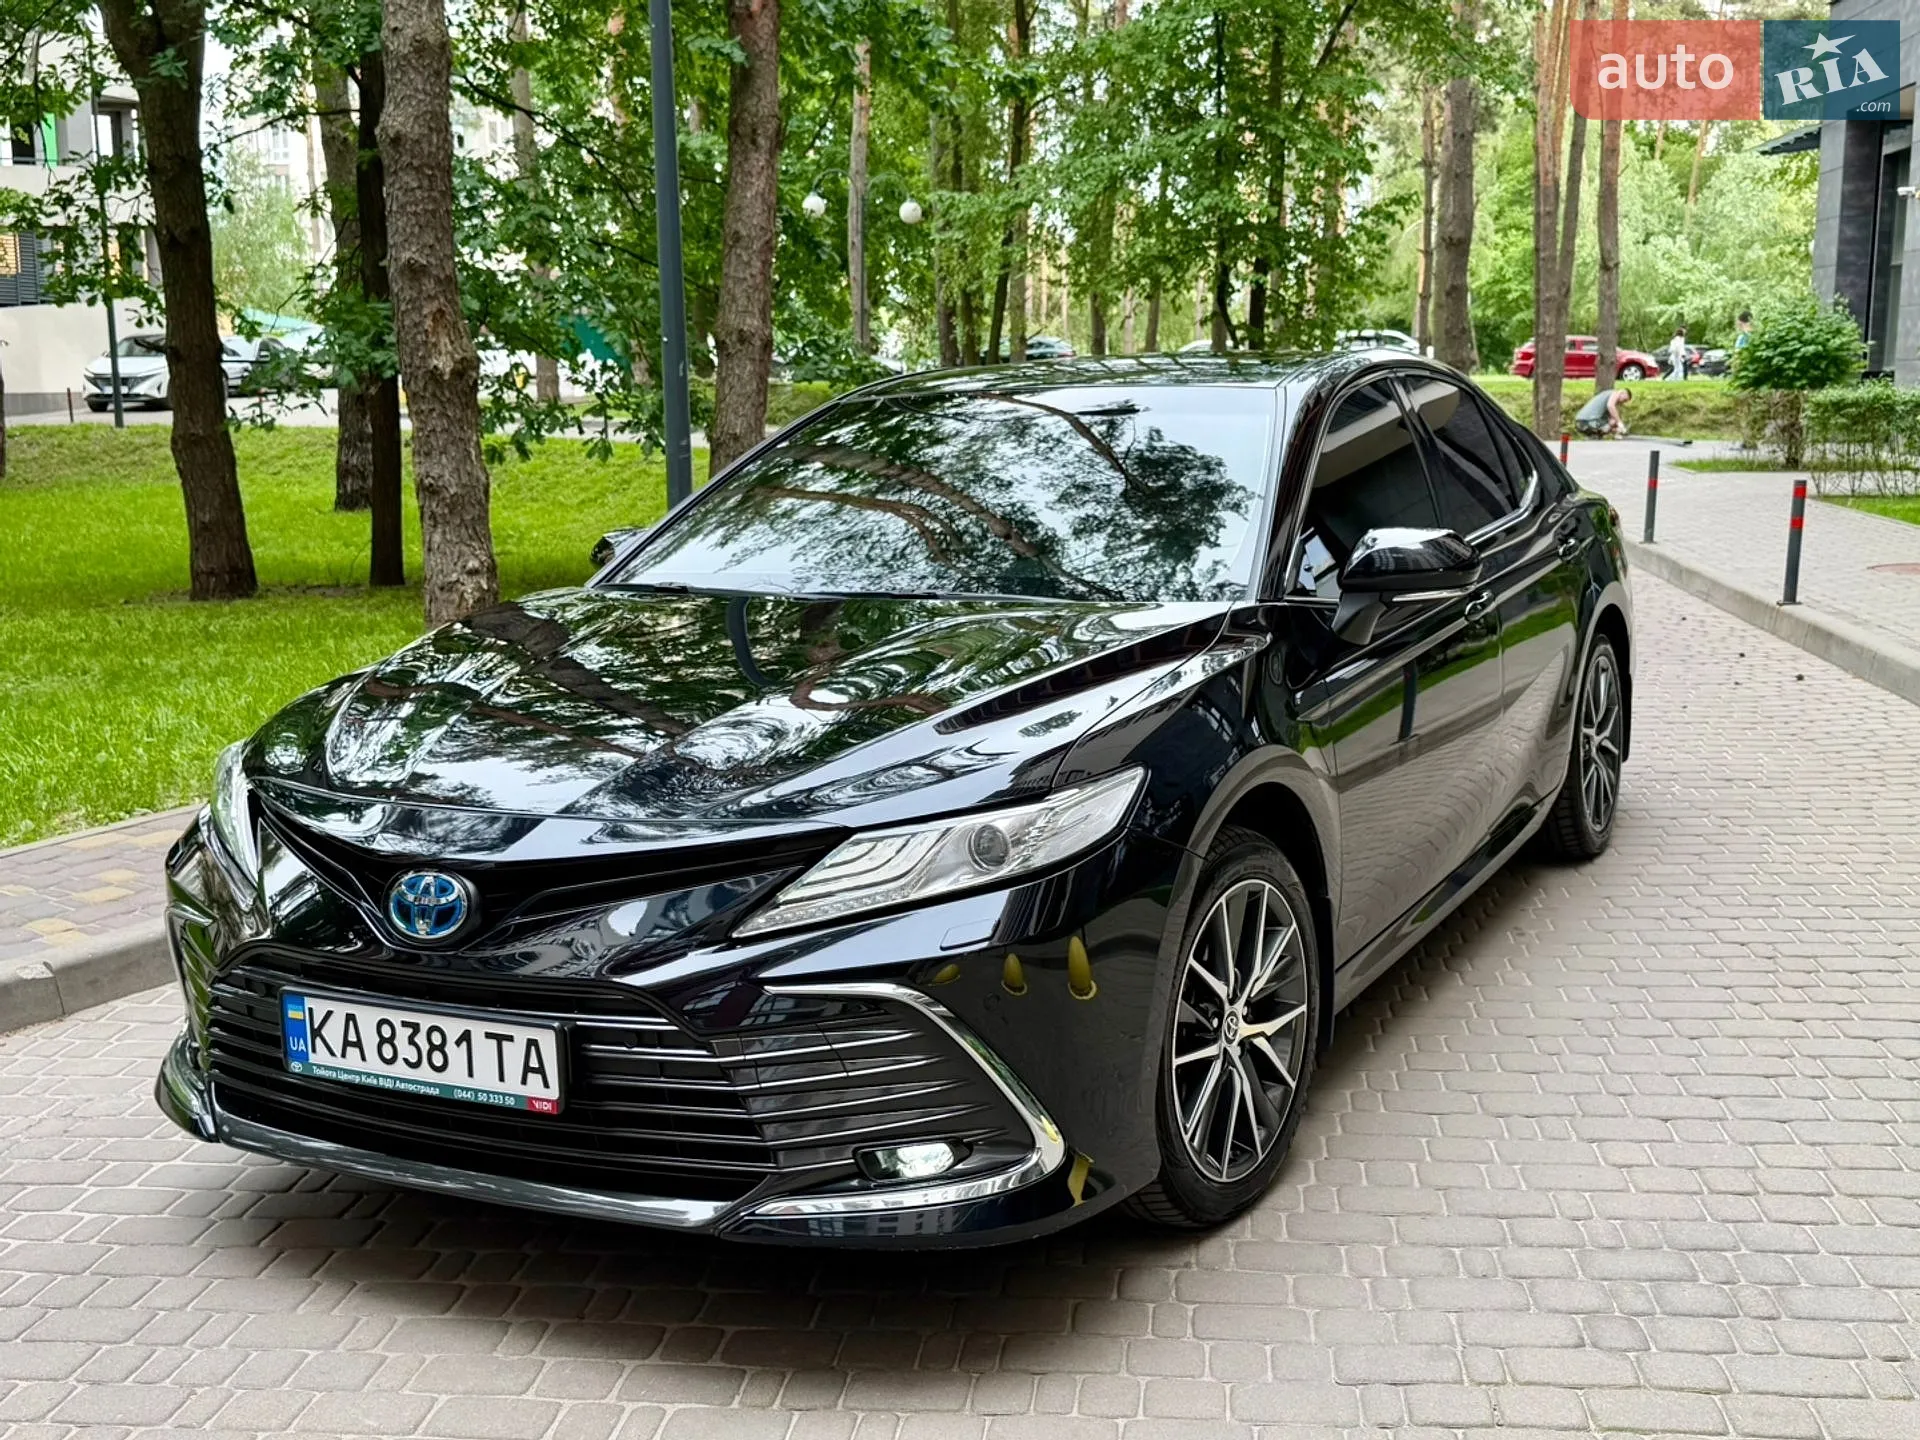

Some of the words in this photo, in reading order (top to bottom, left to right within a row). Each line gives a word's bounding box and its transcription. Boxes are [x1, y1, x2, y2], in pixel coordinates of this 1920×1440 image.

[289, 1035, 307, 1052] UA
[307, 1006, 367, 1063] KA
[376, 1017, 475, 1079] 8381
[484, 1031, 551, 1090] TA
